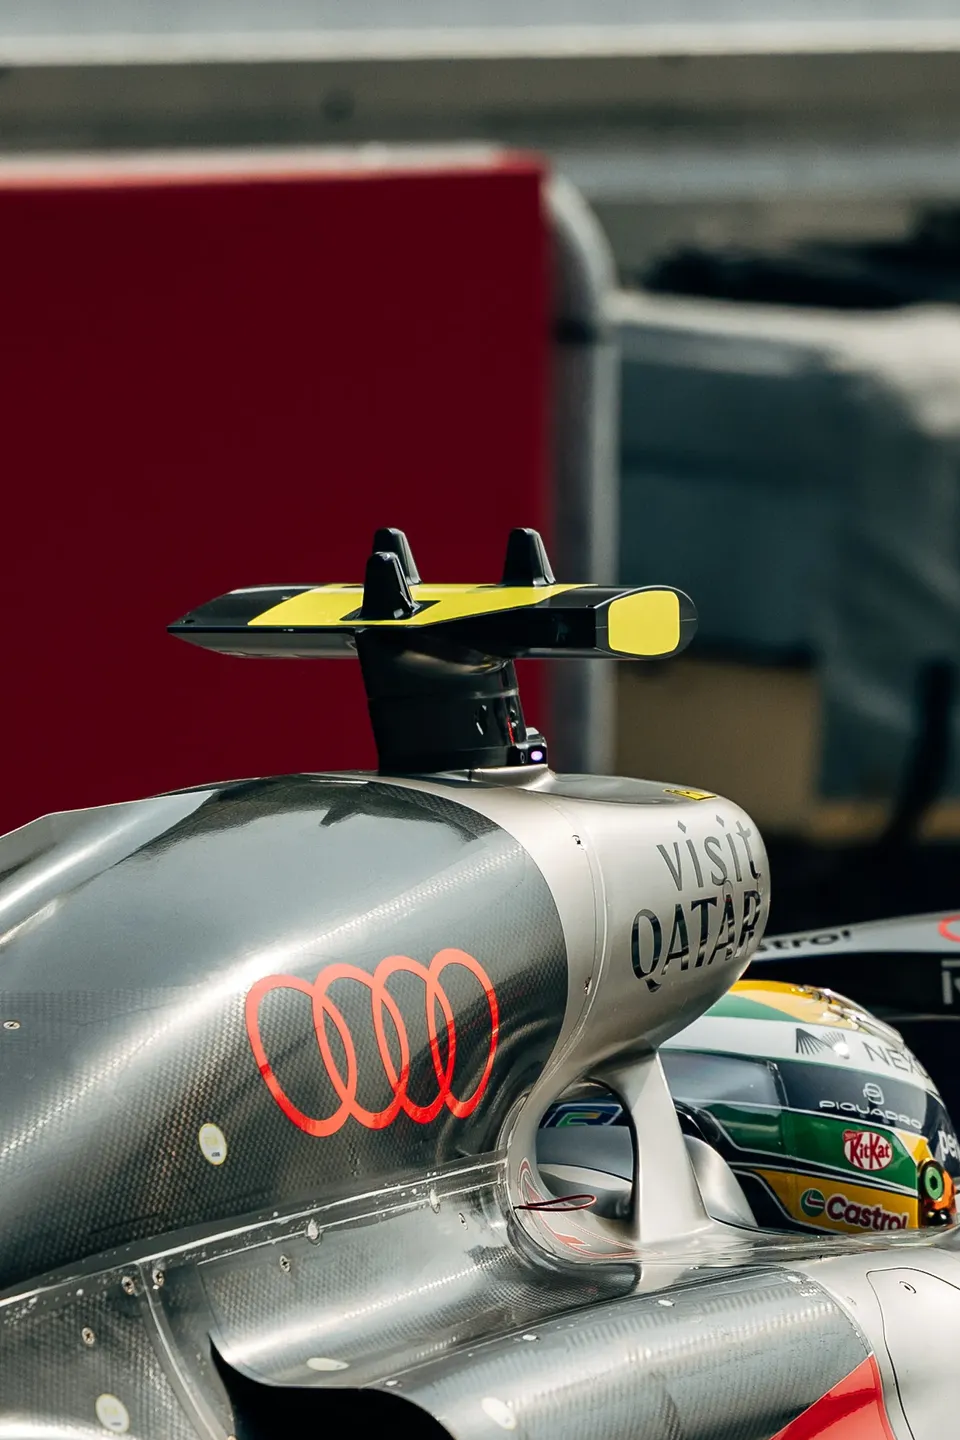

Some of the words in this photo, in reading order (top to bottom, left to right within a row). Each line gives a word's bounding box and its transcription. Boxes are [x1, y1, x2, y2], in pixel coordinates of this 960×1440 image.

[656, 814, 762, 891] visit
[631, 890, 762, 992] QATAR
[819, 1099, 924, 1131] PIQUADRO
[850, 1131, 891, 1169] KitKat
[825, 1193, 910, 1231] Castrol
